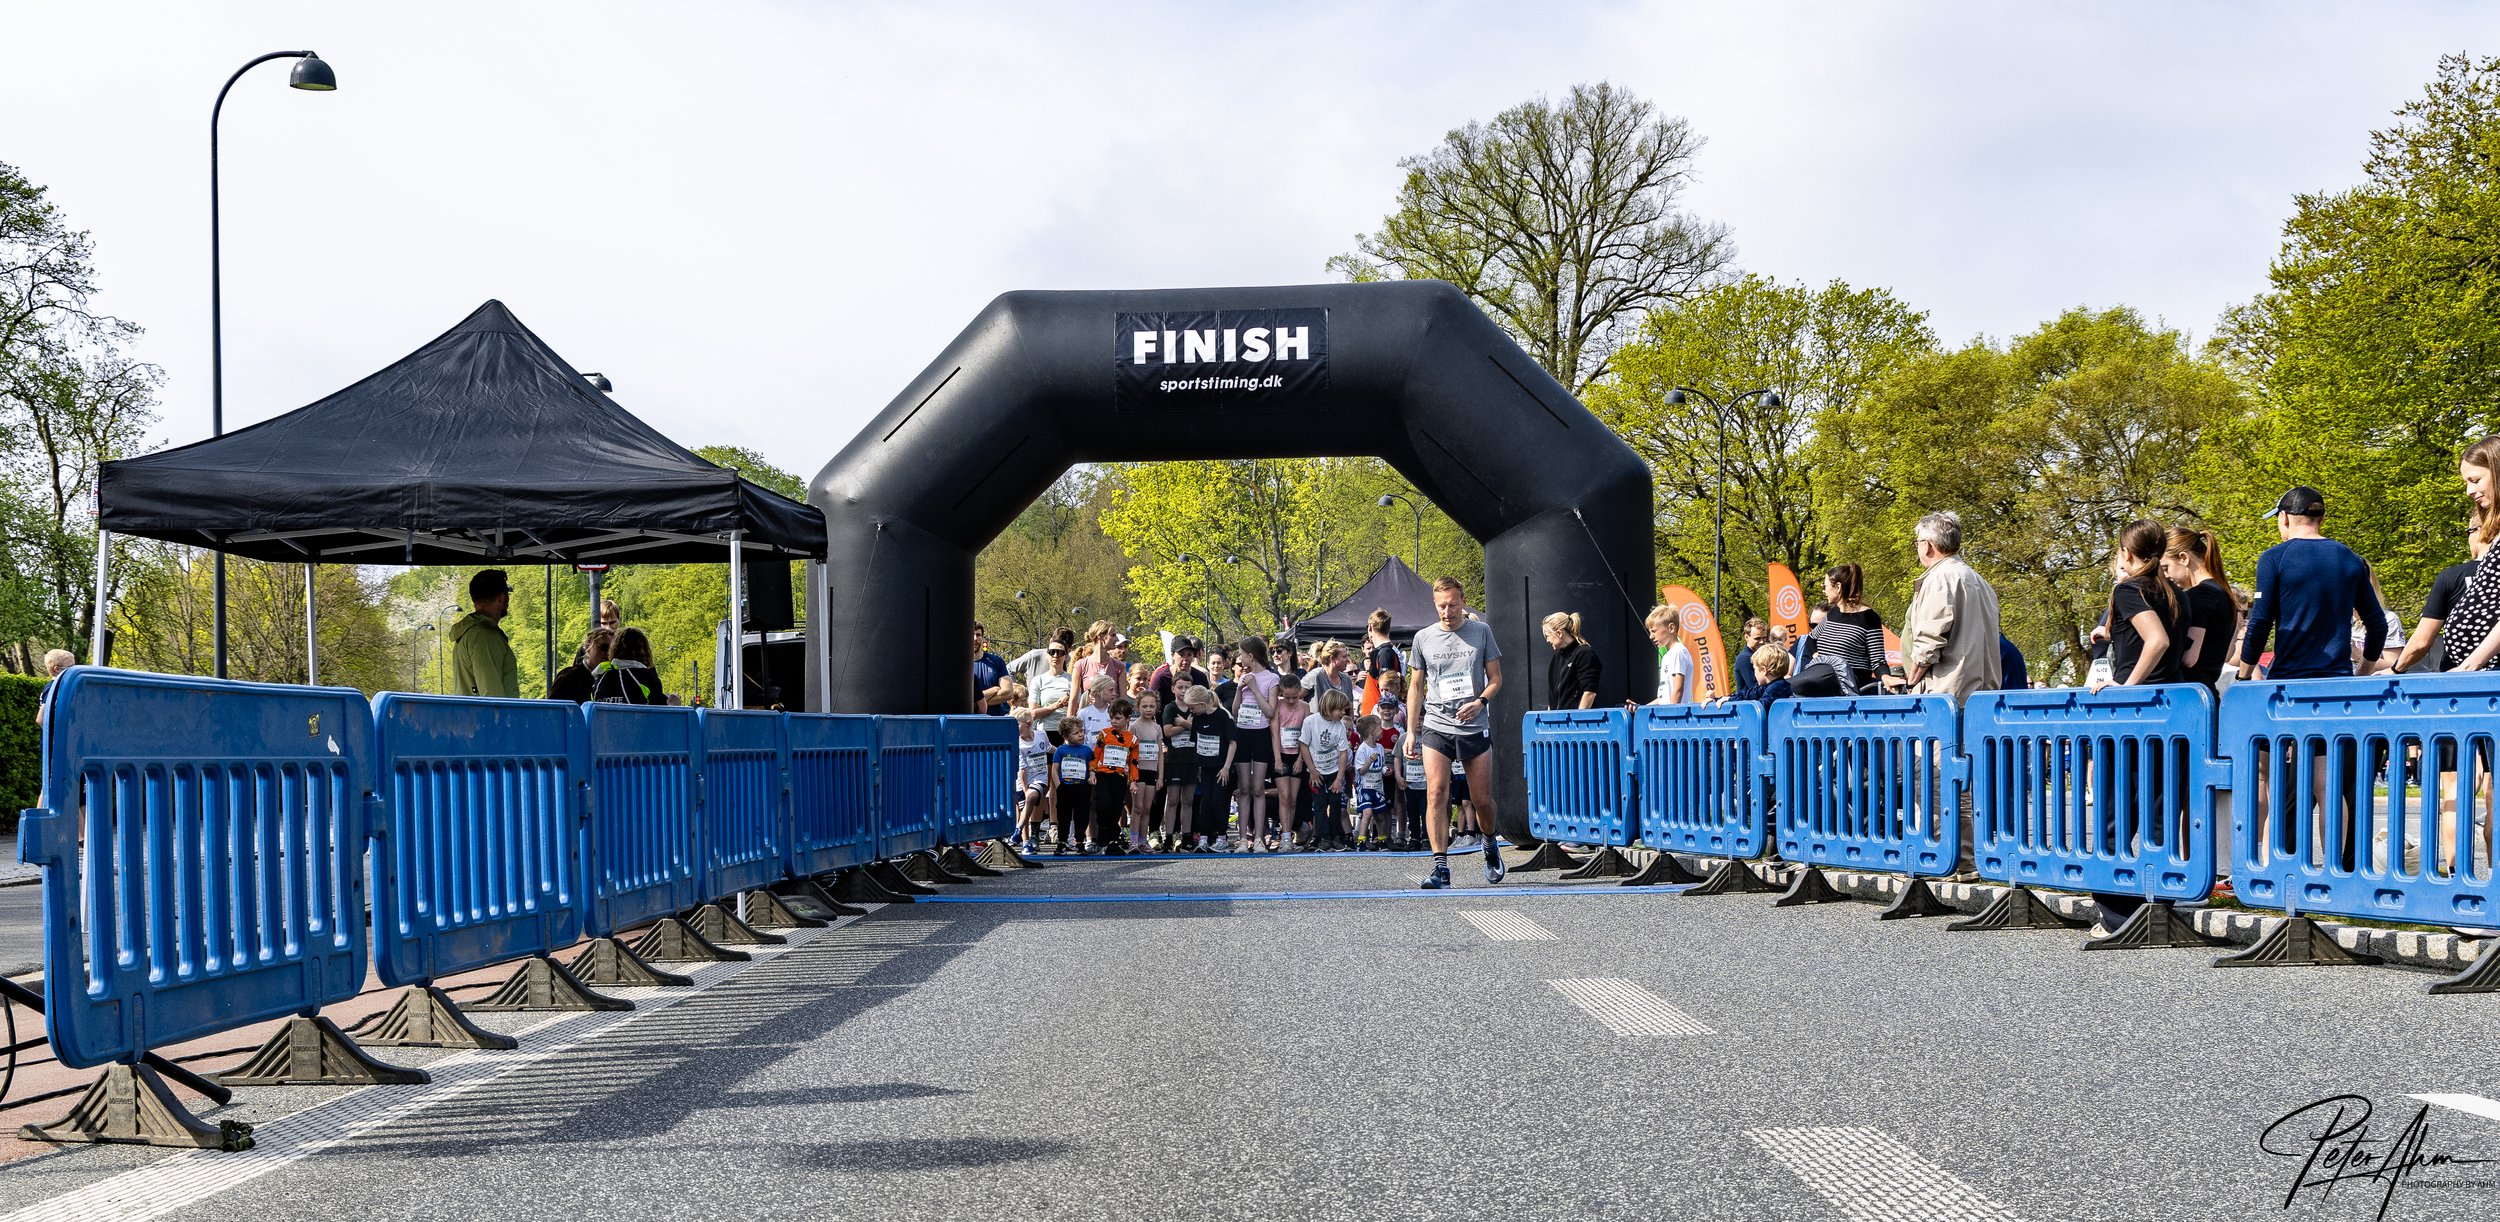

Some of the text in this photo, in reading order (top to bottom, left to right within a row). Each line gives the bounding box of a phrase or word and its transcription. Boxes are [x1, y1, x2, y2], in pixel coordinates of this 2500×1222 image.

[1133, 326, 1310, 365] FINISH
[1159, 374, 1283, 393] sportstiming.dk
[1432, 649, 1474, 660] SAYSKY
